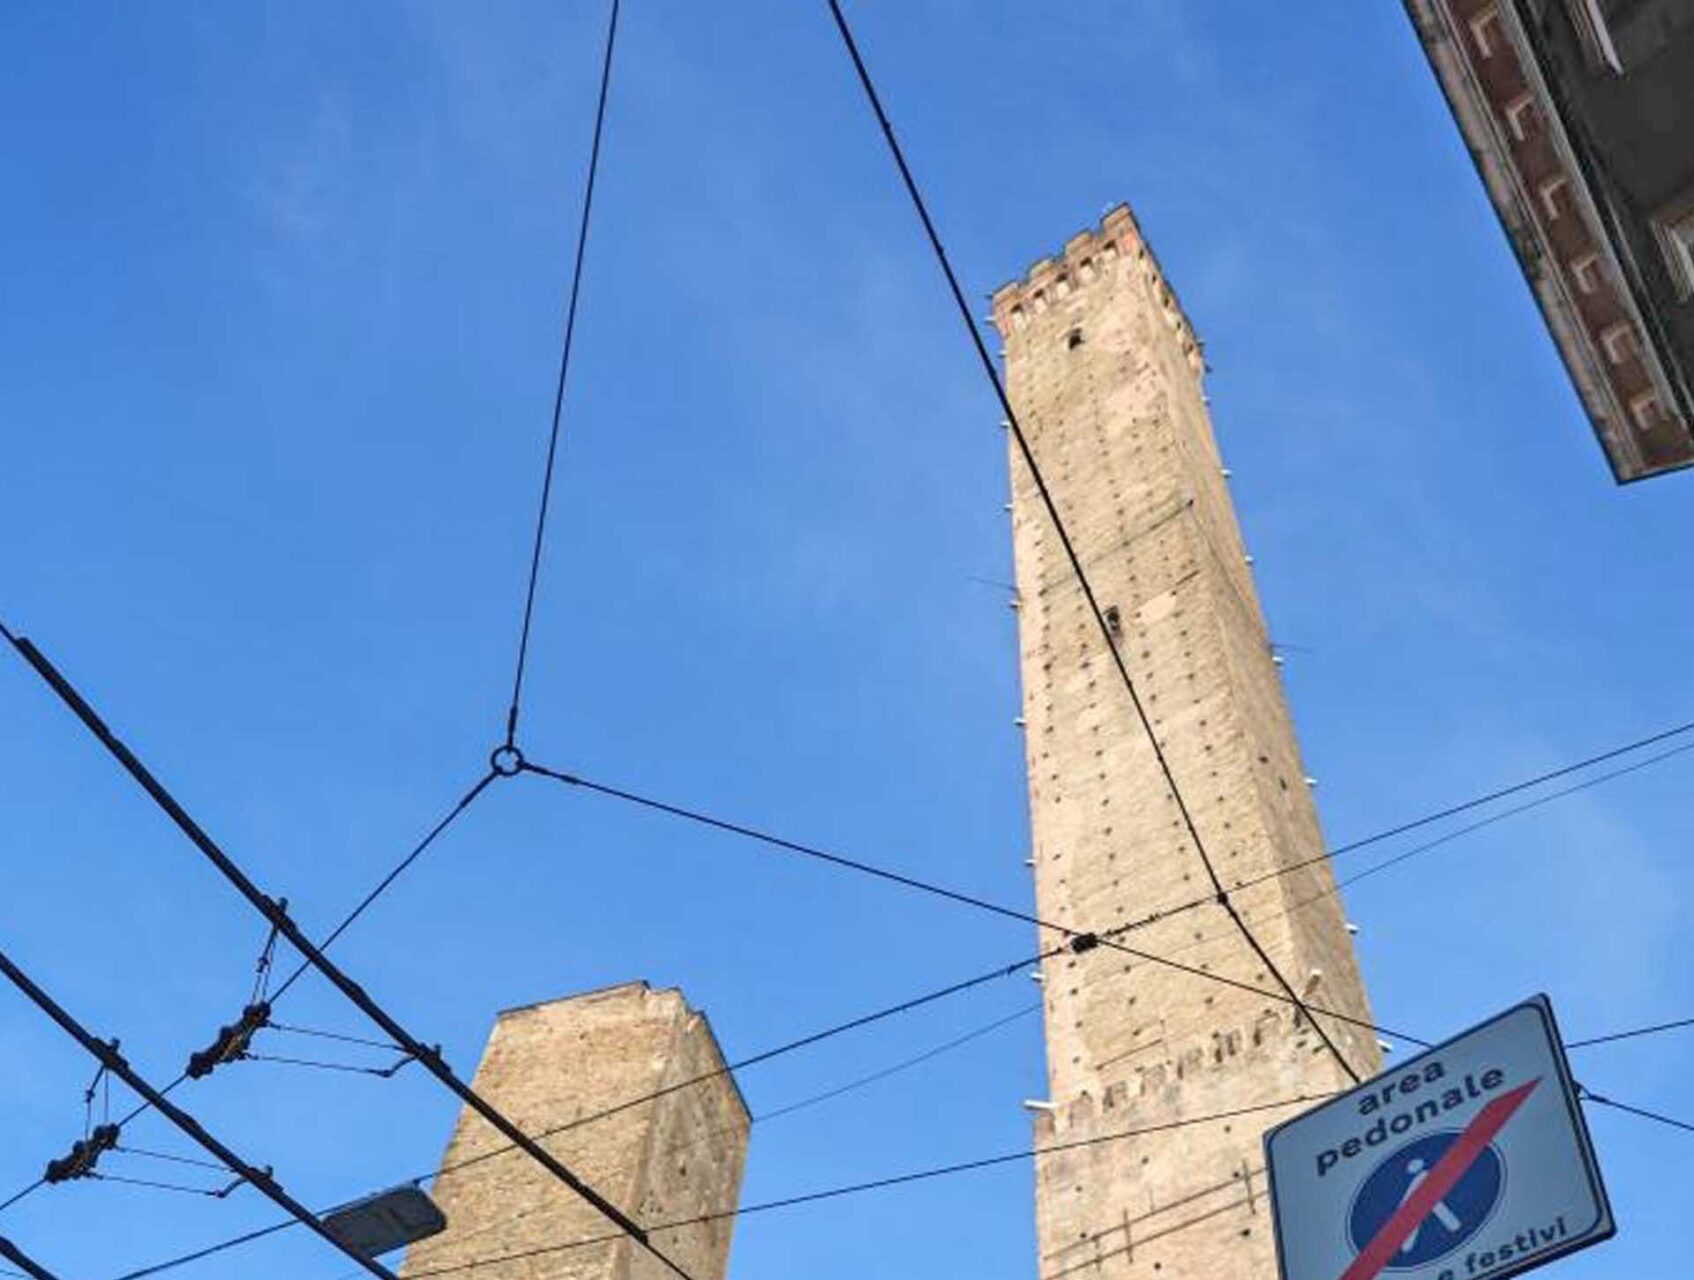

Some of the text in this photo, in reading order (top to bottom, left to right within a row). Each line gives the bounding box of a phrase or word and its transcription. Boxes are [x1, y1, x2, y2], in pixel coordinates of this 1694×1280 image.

[1358, 1061, 1446, 1116] area
[1316, 1068, 1505, 1178] pedonale
[1464, 1217, 1568, 1273] festivi
